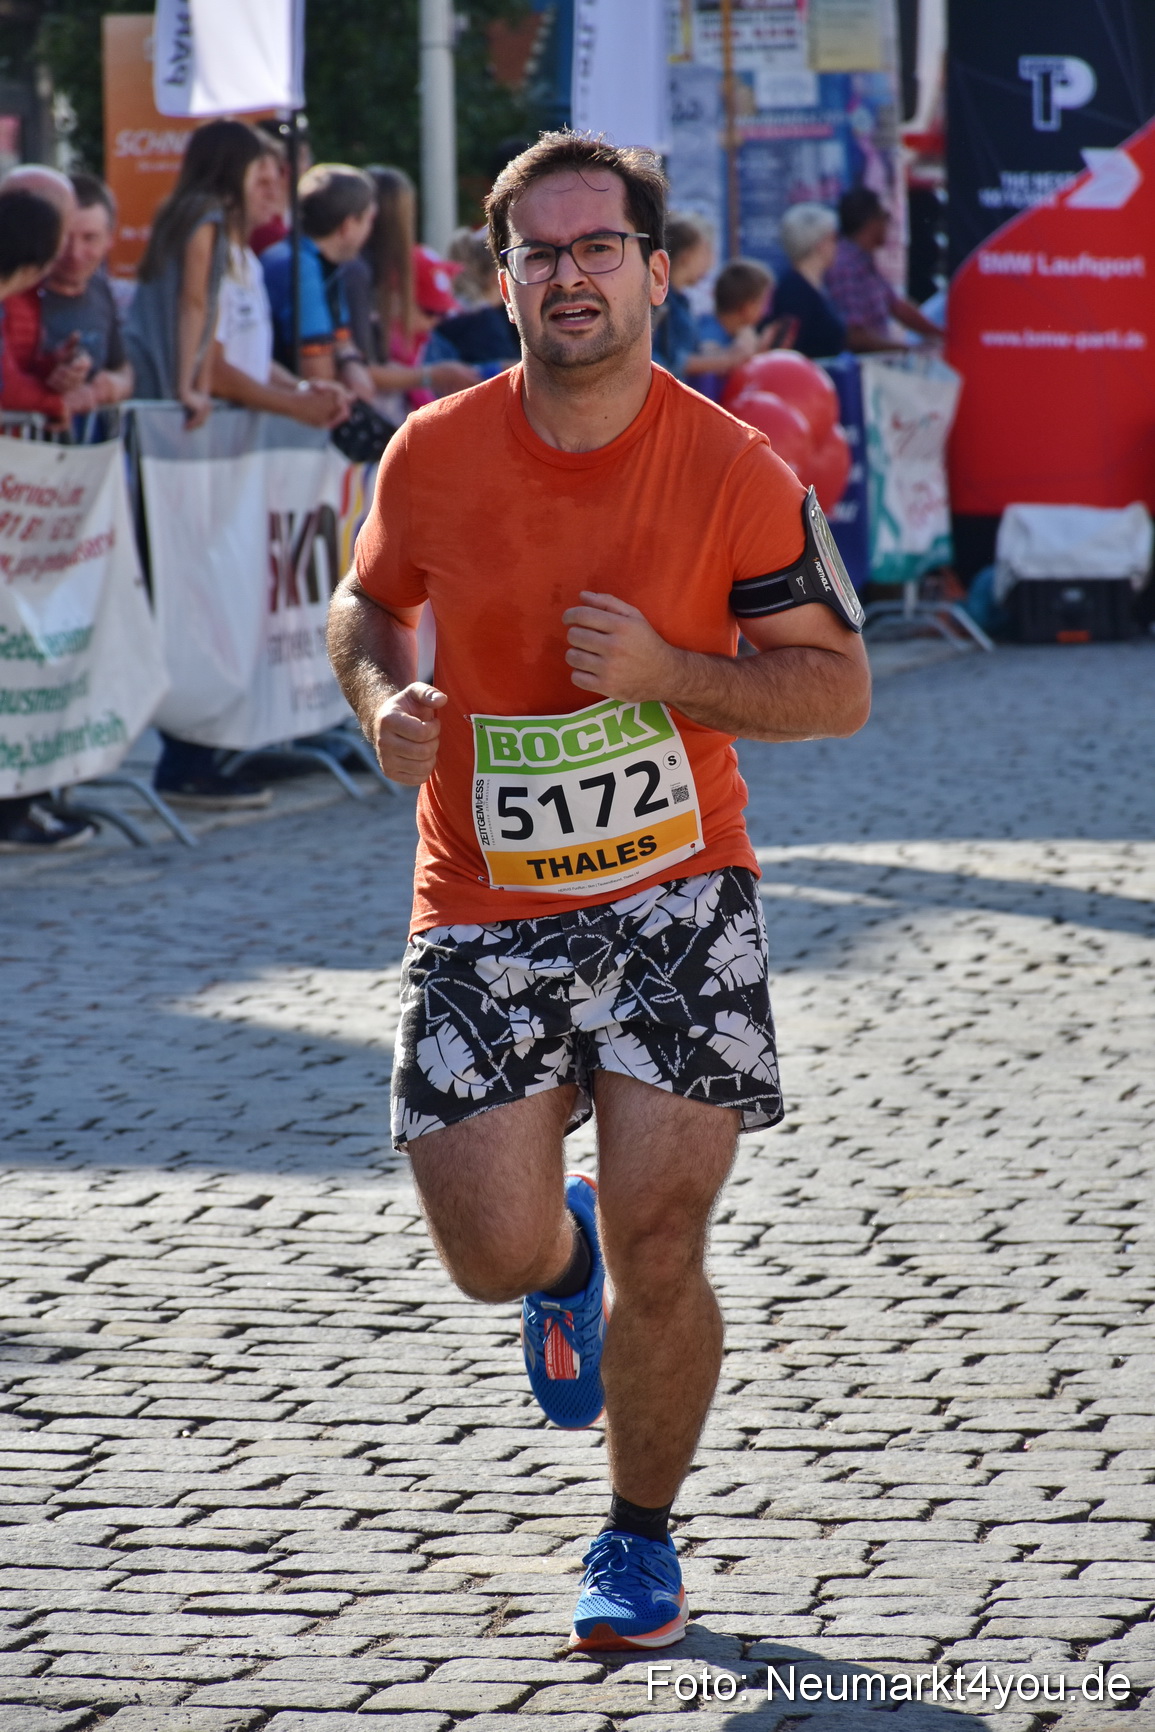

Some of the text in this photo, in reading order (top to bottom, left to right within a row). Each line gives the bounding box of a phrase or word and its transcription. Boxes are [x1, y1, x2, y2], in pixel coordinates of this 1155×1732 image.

[488, 703, 653, 765] BOCK
[498, 760, 669, 840] 5172
[526, 834, 658, 880] THALES
